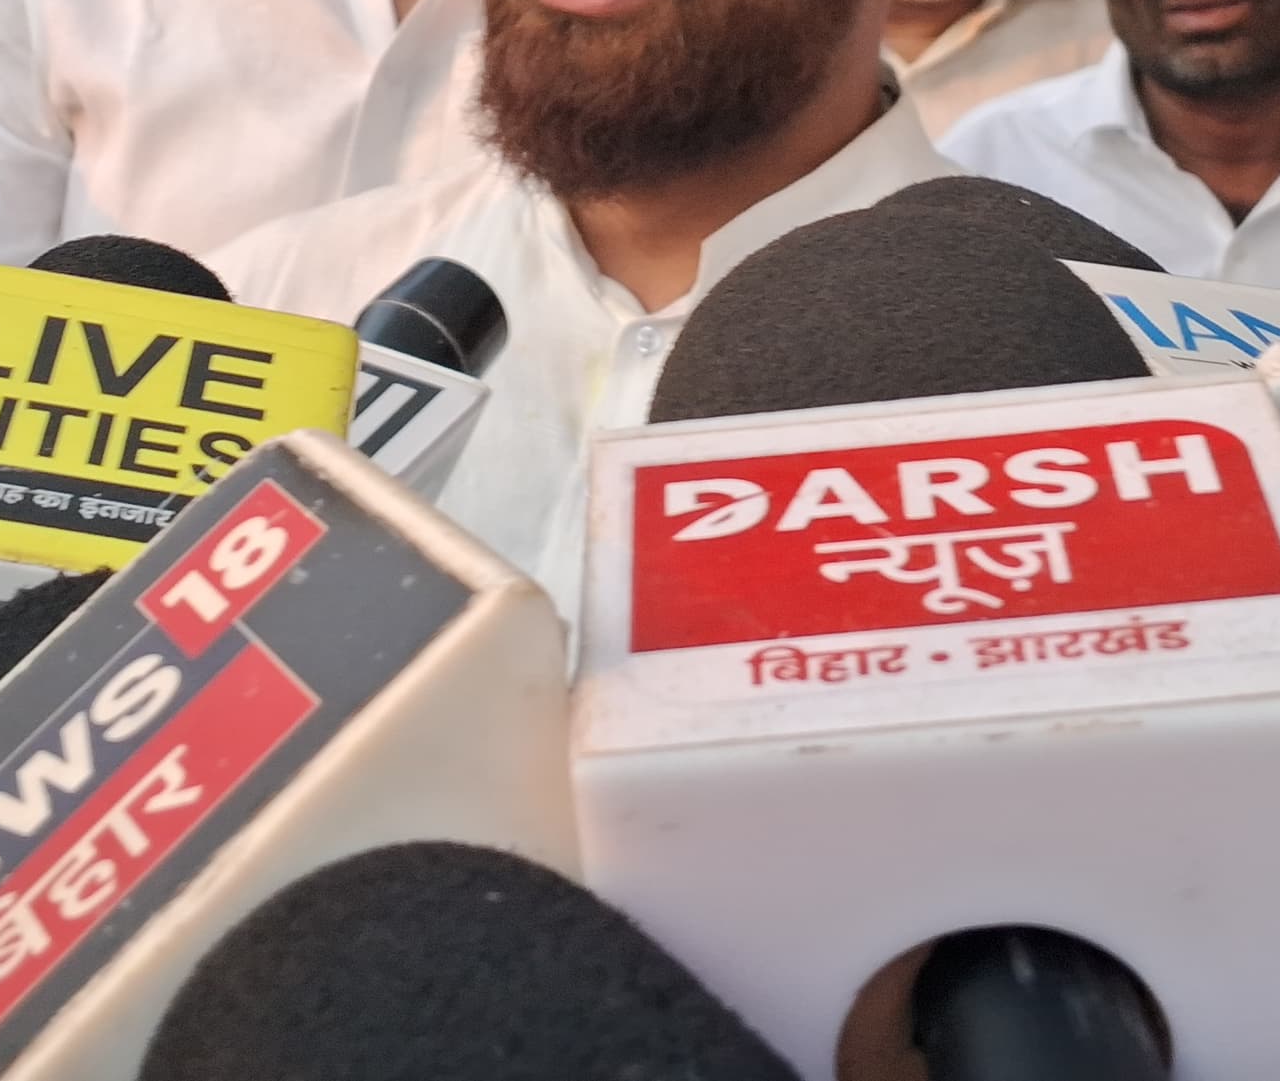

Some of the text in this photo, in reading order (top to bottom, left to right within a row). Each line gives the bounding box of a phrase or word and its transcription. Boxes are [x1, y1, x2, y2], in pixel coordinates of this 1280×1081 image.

[30, 488, 73, 510] का
[663, 433, 1223, 542] DARSH
[160, 516, 292, 624] 18
[814, 521, 1077, 613] न्यूज़
[746, 617, 1193, 688] बिहार झारखंड
